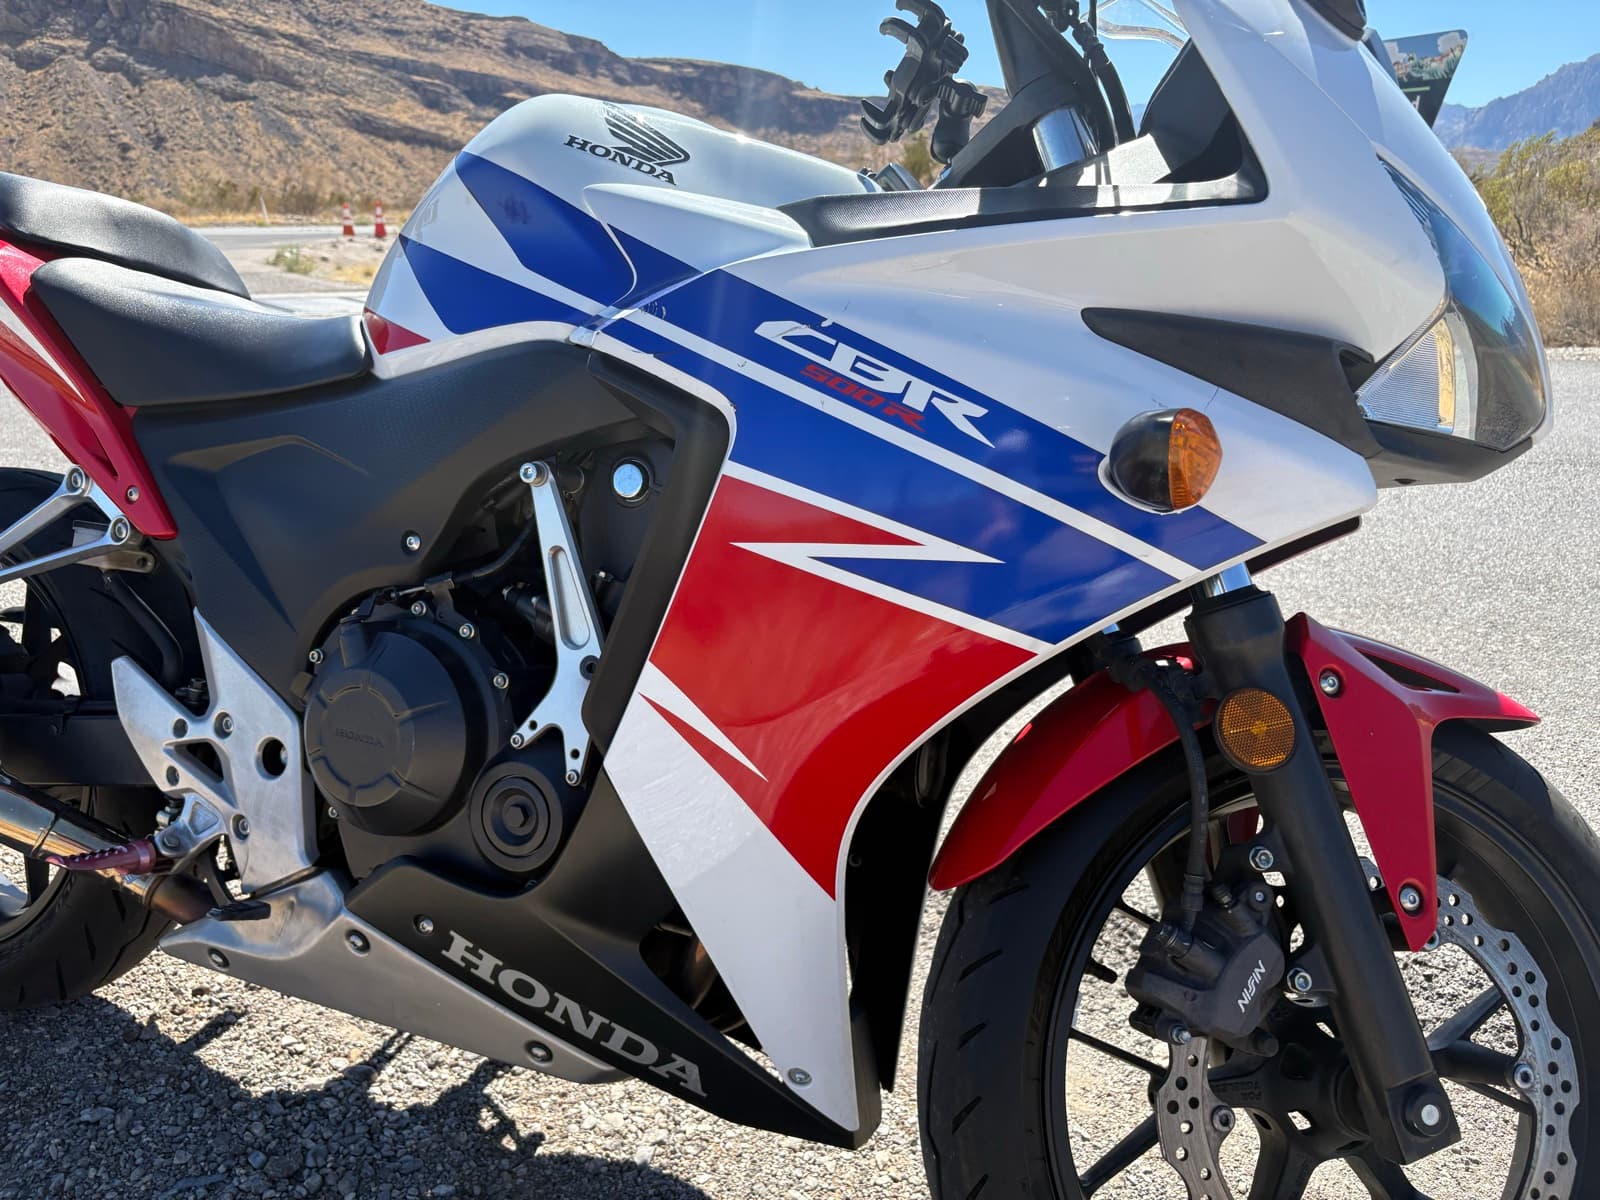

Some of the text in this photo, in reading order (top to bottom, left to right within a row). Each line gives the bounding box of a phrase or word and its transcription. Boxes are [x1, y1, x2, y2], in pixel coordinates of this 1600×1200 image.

[563, 134, 677, 186] HONDA
[753, 318, 996, 449] CBR
[335, 727, 385, 750] HONDA
[441, 930, 708, 1098] HONDA
[1237, 959, 1266, 1014] NISSIN
